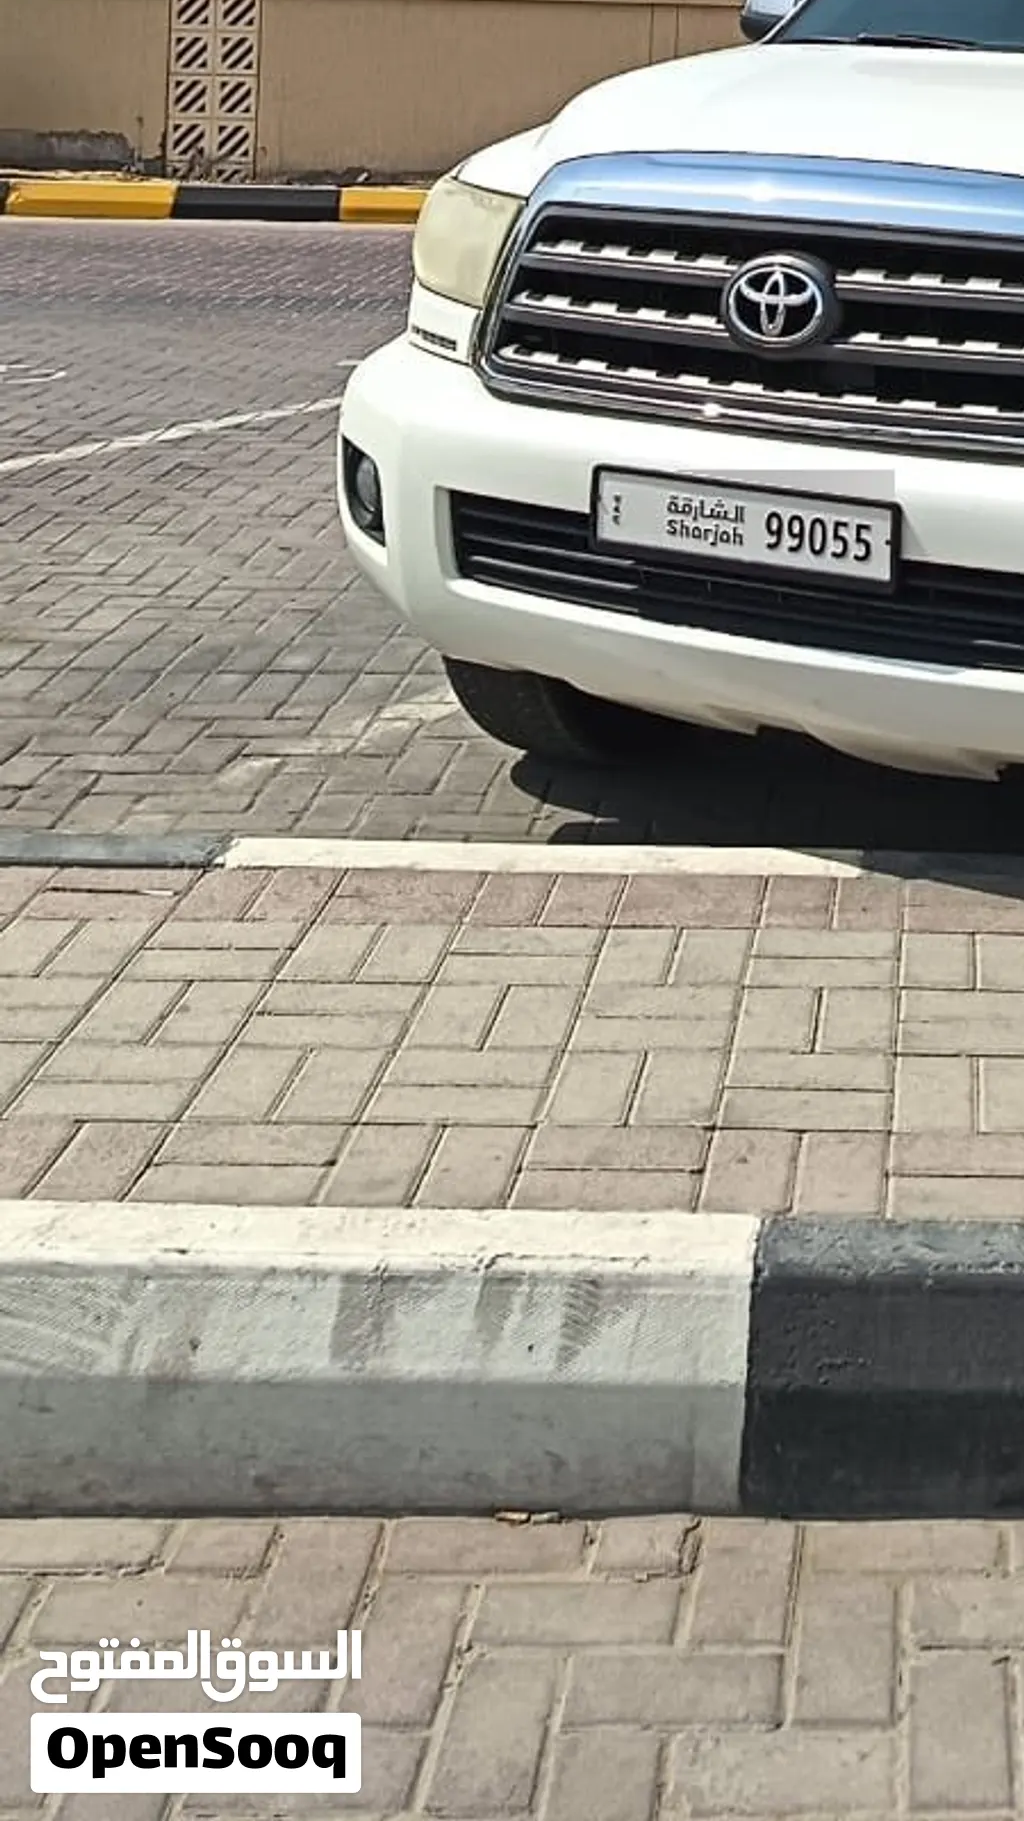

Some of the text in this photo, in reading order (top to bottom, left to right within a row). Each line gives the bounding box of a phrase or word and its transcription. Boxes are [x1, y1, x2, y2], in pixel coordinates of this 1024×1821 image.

[666, 494, 745, 524] الشارقة
[666, 518, 744, 547] Sharjah
[765, 510, 872, 562] 99055
